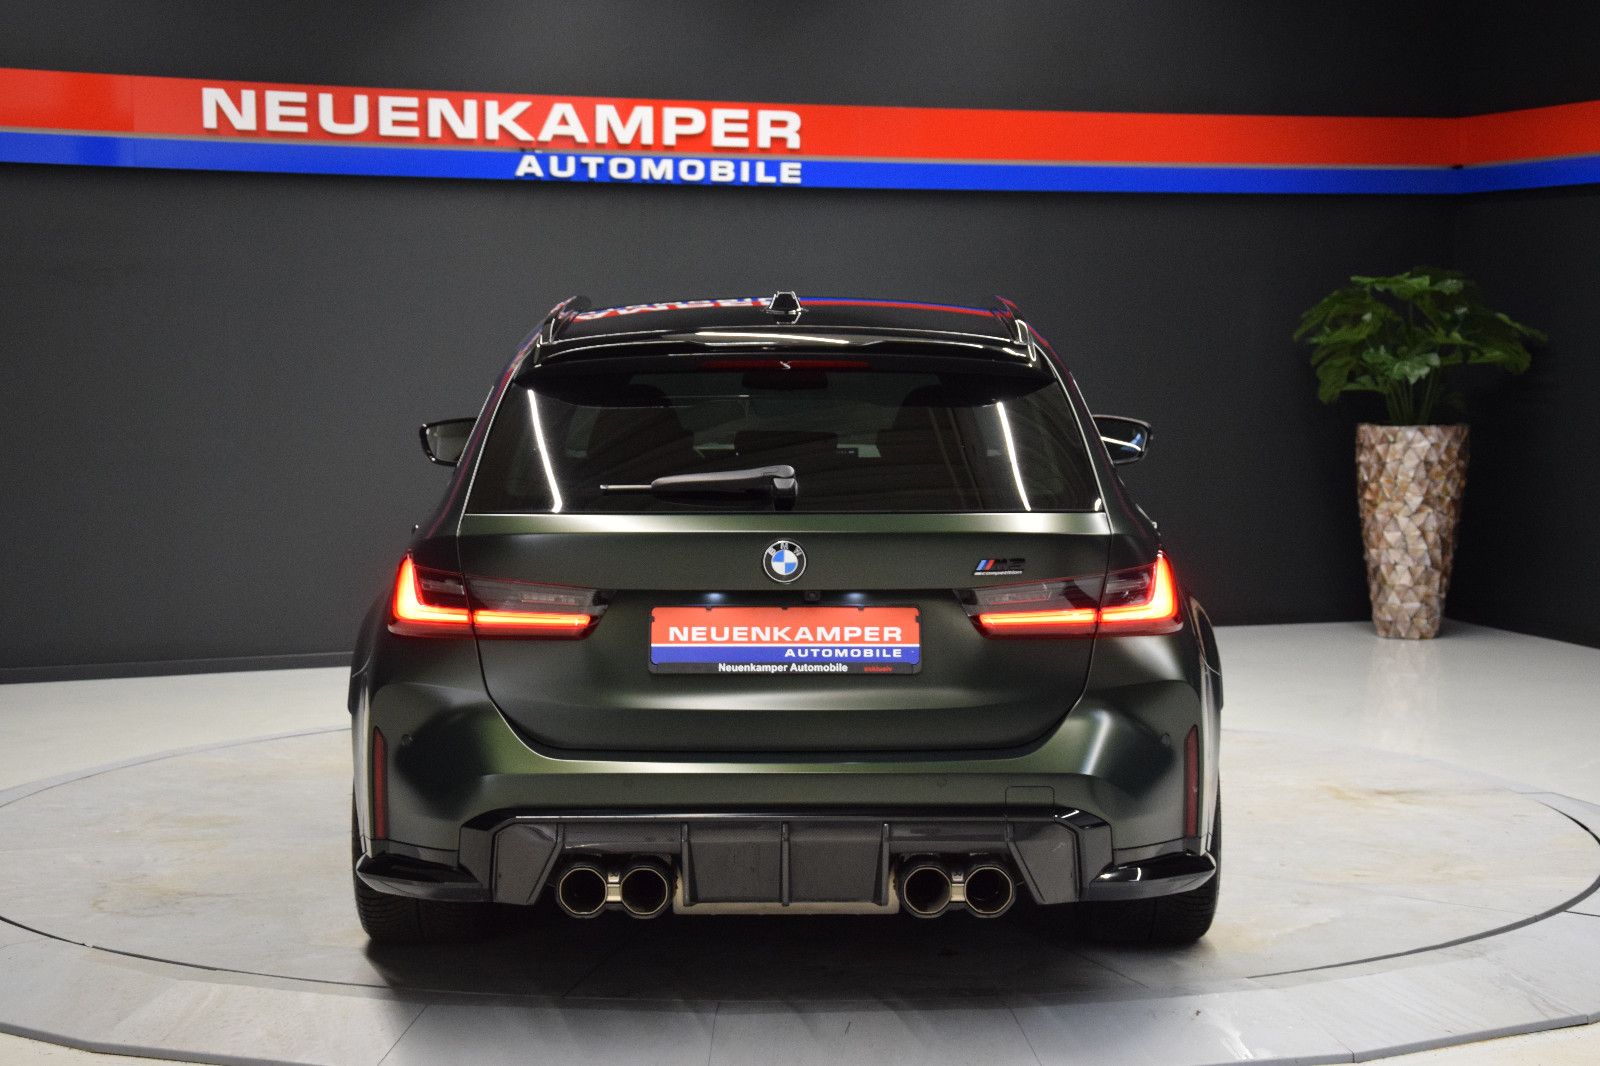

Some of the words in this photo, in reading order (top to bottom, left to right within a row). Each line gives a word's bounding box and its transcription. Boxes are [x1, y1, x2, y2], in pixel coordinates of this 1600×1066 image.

[201, 87, 803, 150] NEUENKAMPER
[514, 153, 803, 185] AUTOMOBILE
[668, 626, 903, 642] NEUENKAMPER
[784, 648, 903, 658] AUTOMOBILE
[718, 663, 788, 674] Neuenkamper
[789, 663, 849, 673] Automobile
